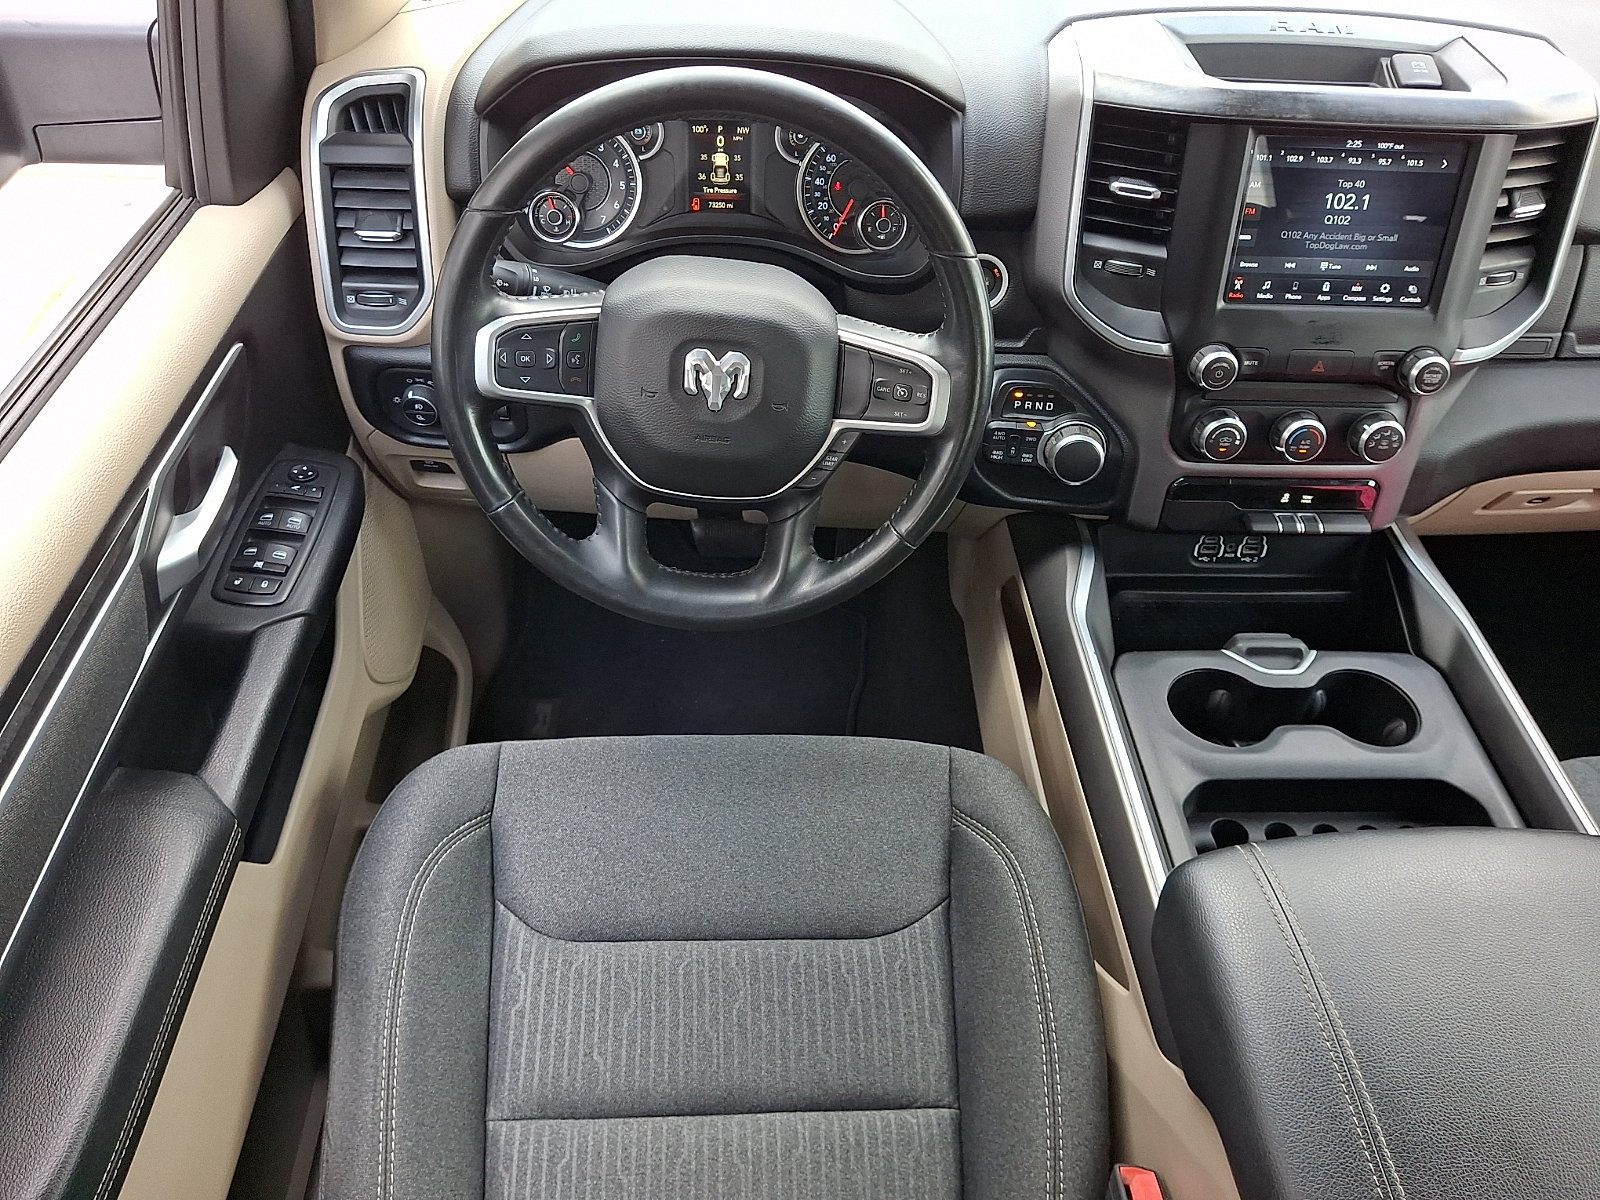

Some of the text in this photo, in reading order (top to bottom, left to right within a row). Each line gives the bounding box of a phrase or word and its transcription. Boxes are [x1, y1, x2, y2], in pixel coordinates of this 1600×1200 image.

[718, 125, 723, 133] P
[716, 135, 725, 147] 0
[1346, 139, 1363, 148] 2:25
[826, 154, 837, 162] 60
[613, 159, 619, 168] 4
[620, 181, 625, 190] 5
[1338, 180, 1366, 189] Top 40
[818, 202, 828, 210] 20
[1325, 193, 1370, 211] 102.1
[1324, 215, 1351, 226] Q102
[1281, 231, 1302, 240] Q102
[1304, 231, 1318, 240] Any
[1320, 232, 1352, 241] Accident
[1354, 233, 1366, 242] Big
[1377, 234, 1398, 242] Small
[1305, 241, 1367, 250] TopDogLaw.com
[1025, 401, 1032, 409] R
[1035, 402, 1043, 410] N
[1046, 402, 1054, 410] D
